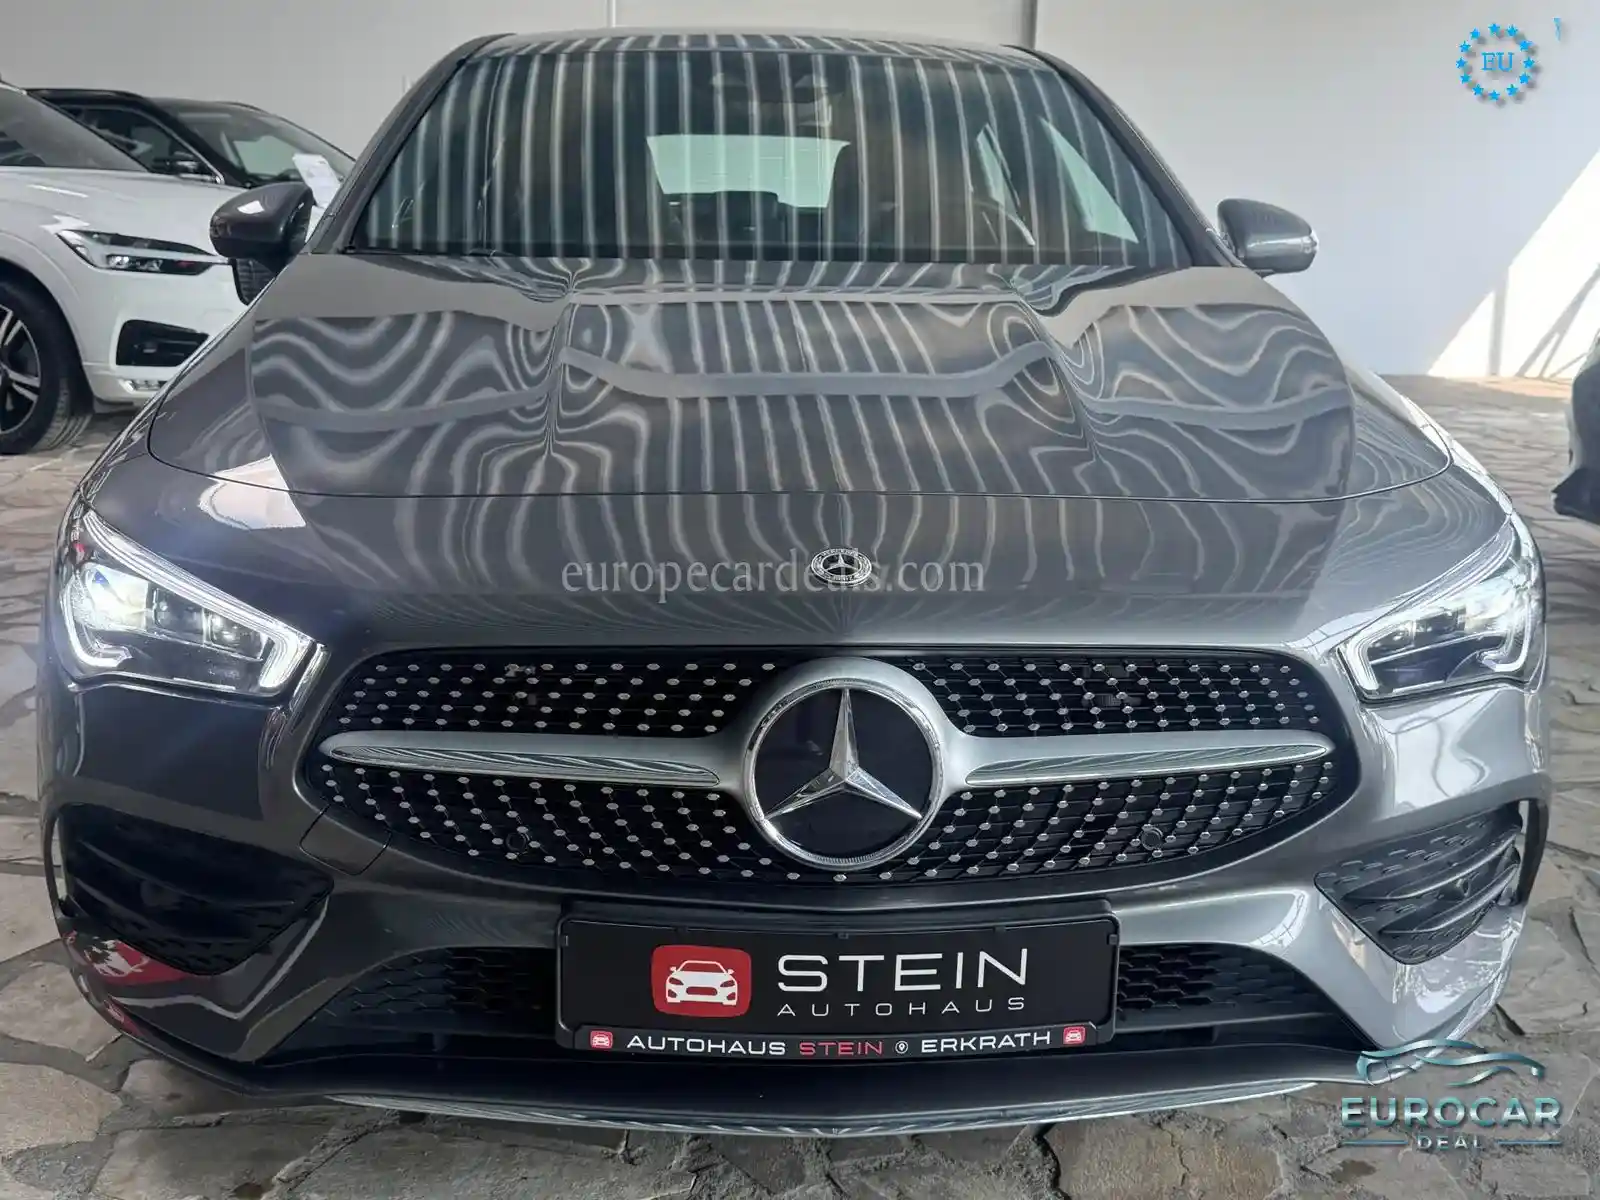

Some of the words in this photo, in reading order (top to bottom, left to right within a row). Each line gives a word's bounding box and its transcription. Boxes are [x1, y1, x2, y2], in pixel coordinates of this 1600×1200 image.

[777, 948, 1028, 992] STEIN
[776, 996, 1025, 1017] AUTOHAUS
[626, 1034, 786, 1055] AUTOHAUS
[799, 1039, 883, 1055] STEIN
[920, 1030, 1052, 1053] ERKRATH
